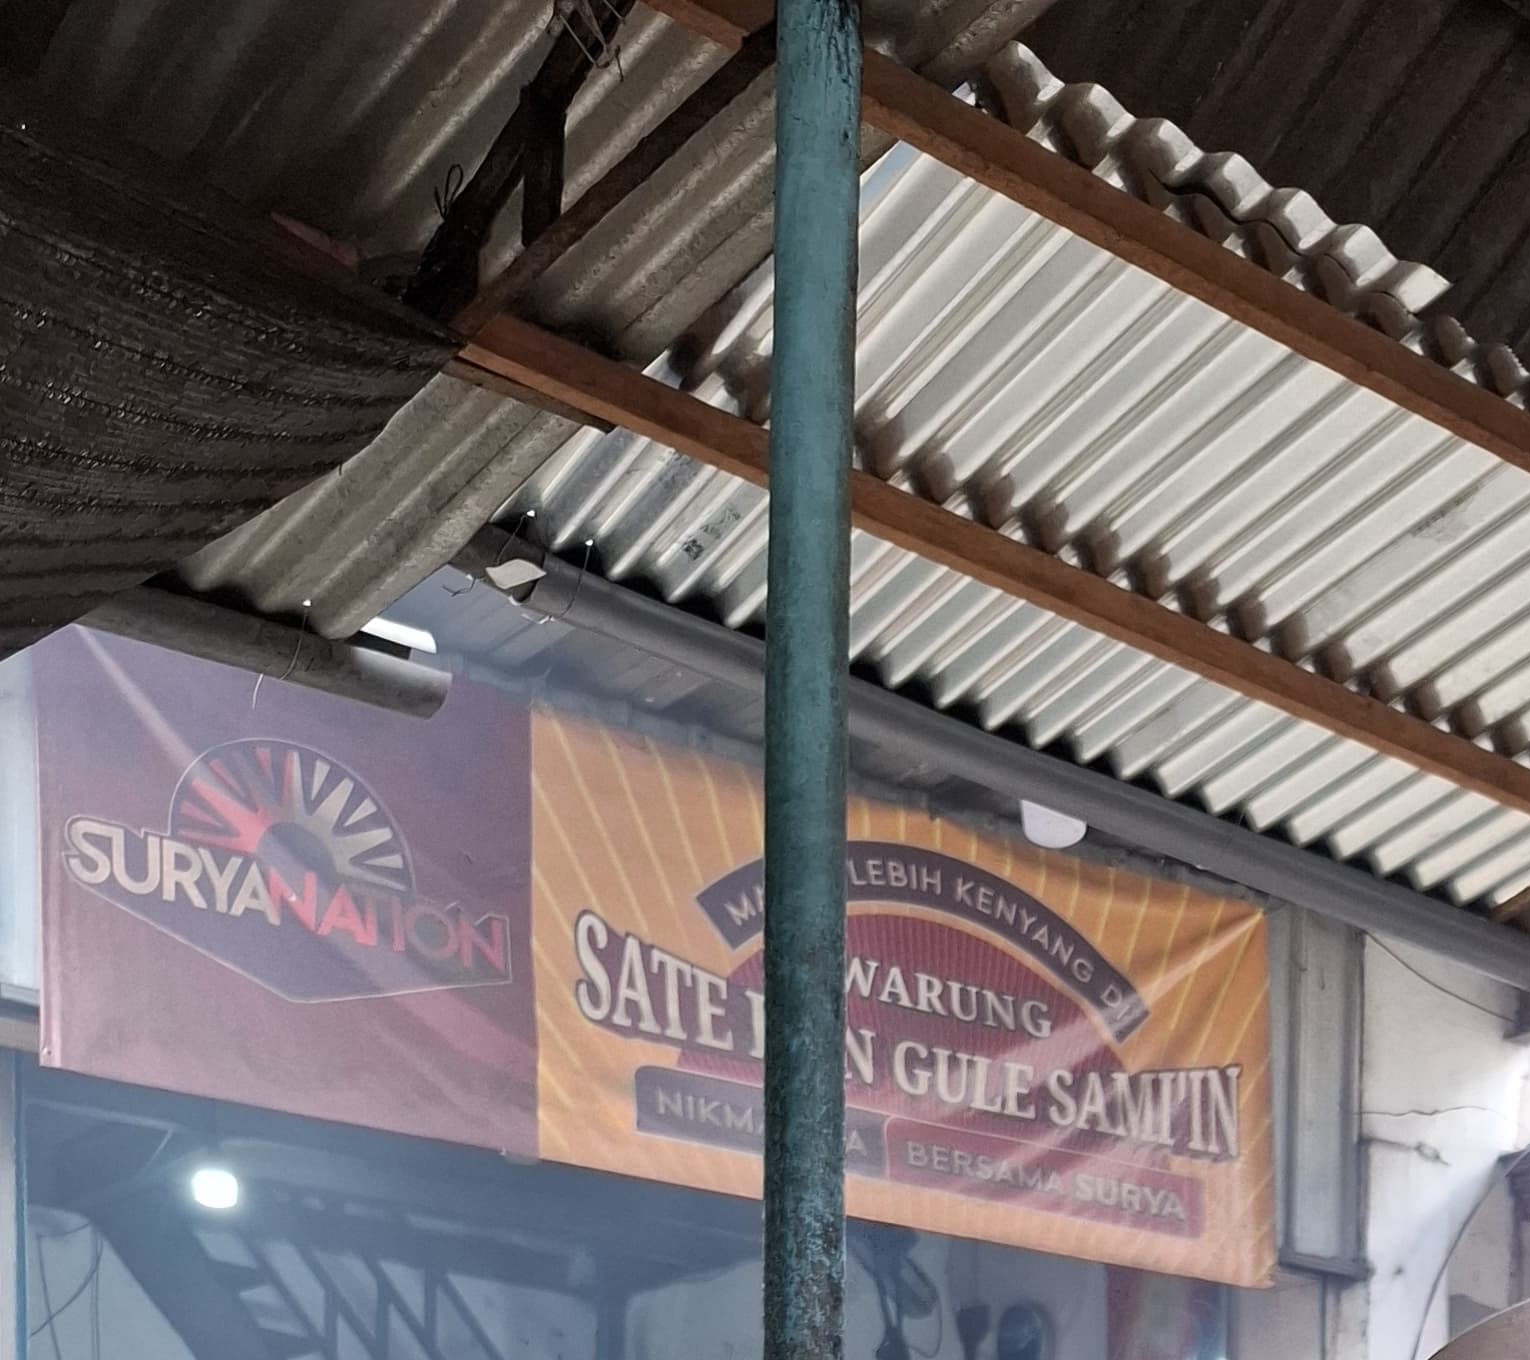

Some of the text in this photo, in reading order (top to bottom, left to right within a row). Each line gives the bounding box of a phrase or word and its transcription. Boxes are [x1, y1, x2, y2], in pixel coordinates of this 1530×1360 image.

[847, 859, 942, 895] LEBIH
[956, 877, 1094, 983] KENYANG
[576, 913, 733, 1051] SATE
[893, 1041, 1036, 1120] GULE
[845, 957, 1051, 1038] WARUNG
[907, 1141, 1063, 1192] BERSAMA
[1074, 1173, 1186, 1222] SURYA
